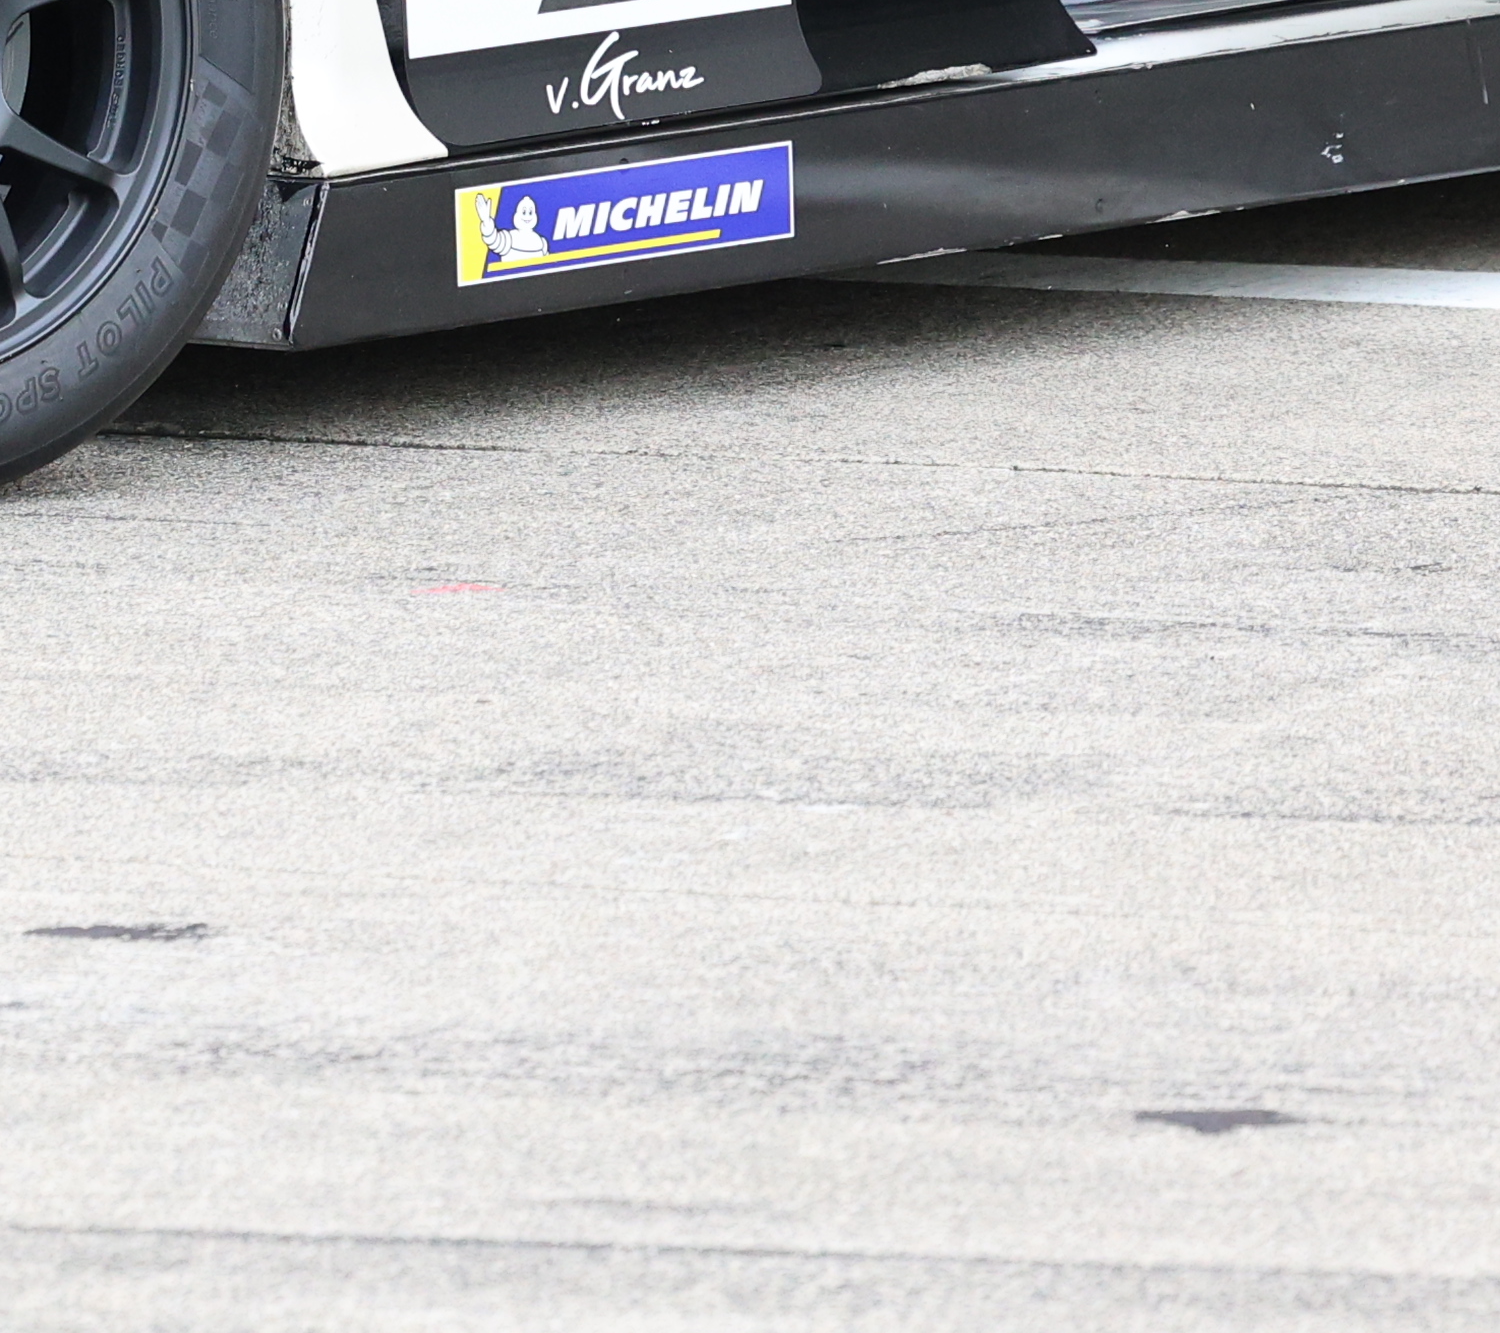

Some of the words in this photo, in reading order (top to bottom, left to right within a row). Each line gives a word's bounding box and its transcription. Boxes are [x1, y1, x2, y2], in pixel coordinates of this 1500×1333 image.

[545, 30, 705, 121] v.Granz
[552, 178, 765, 242] MICHELIN
[76, 255, 173, 380] PILOT
